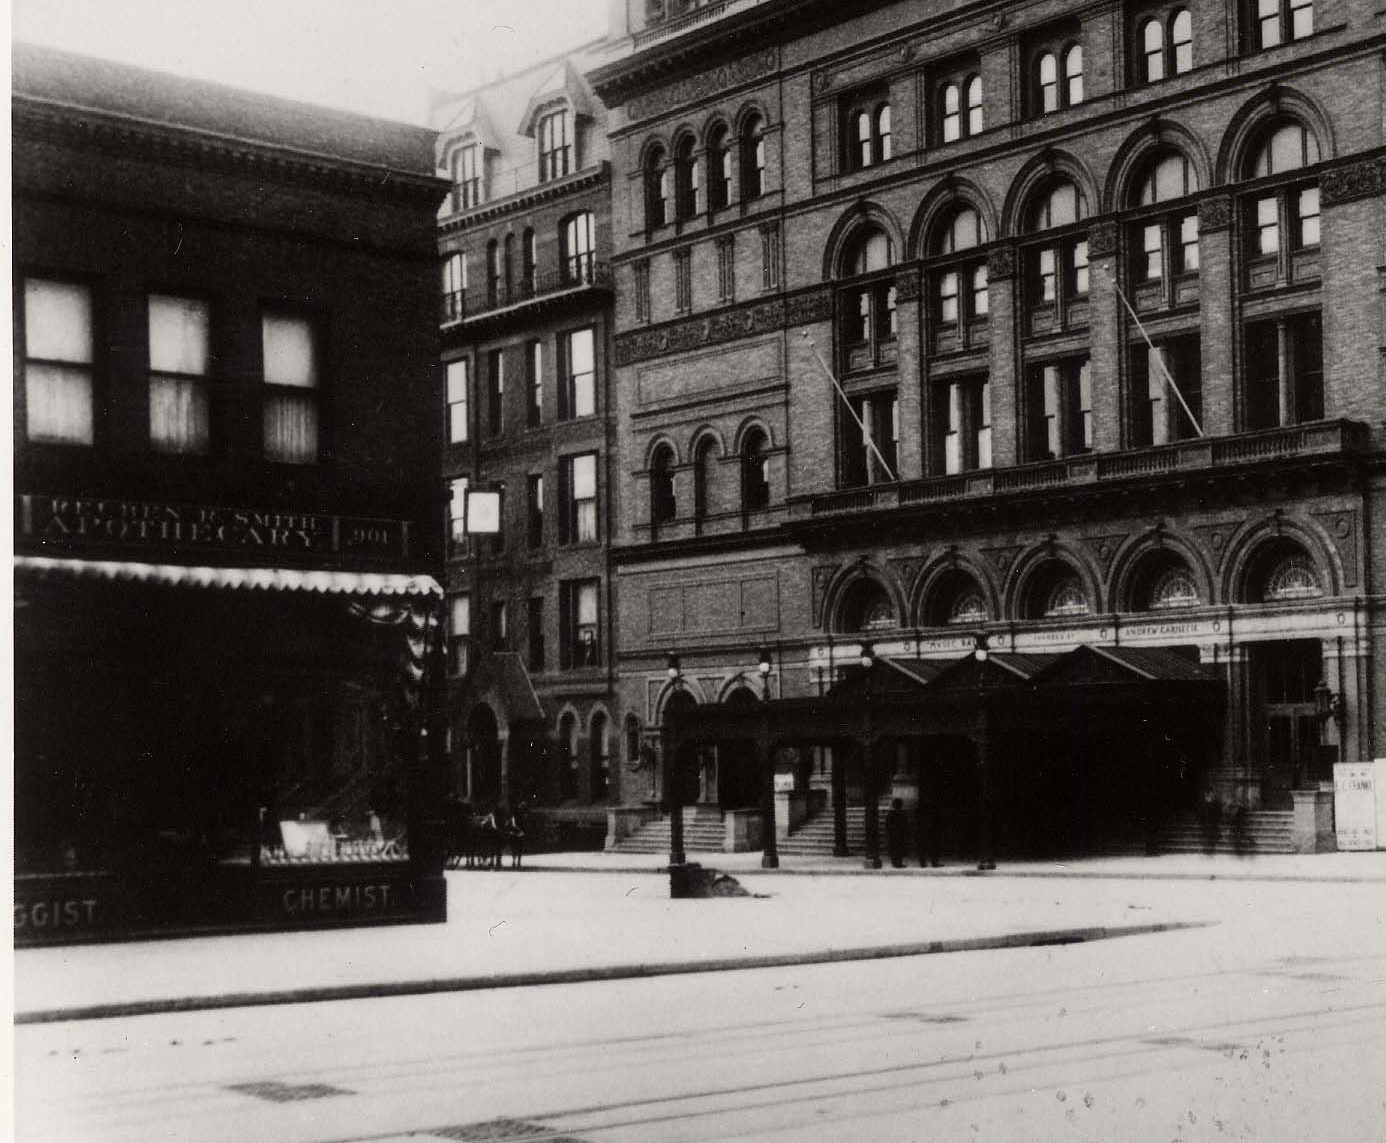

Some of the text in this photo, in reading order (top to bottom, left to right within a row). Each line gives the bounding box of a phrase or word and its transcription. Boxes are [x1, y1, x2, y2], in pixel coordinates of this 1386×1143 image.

[46, 515, 315, 547] APOTHECARY
[234, 513, 317, 530] SMITH
[282, 884, 391, 914] CHEMIST
